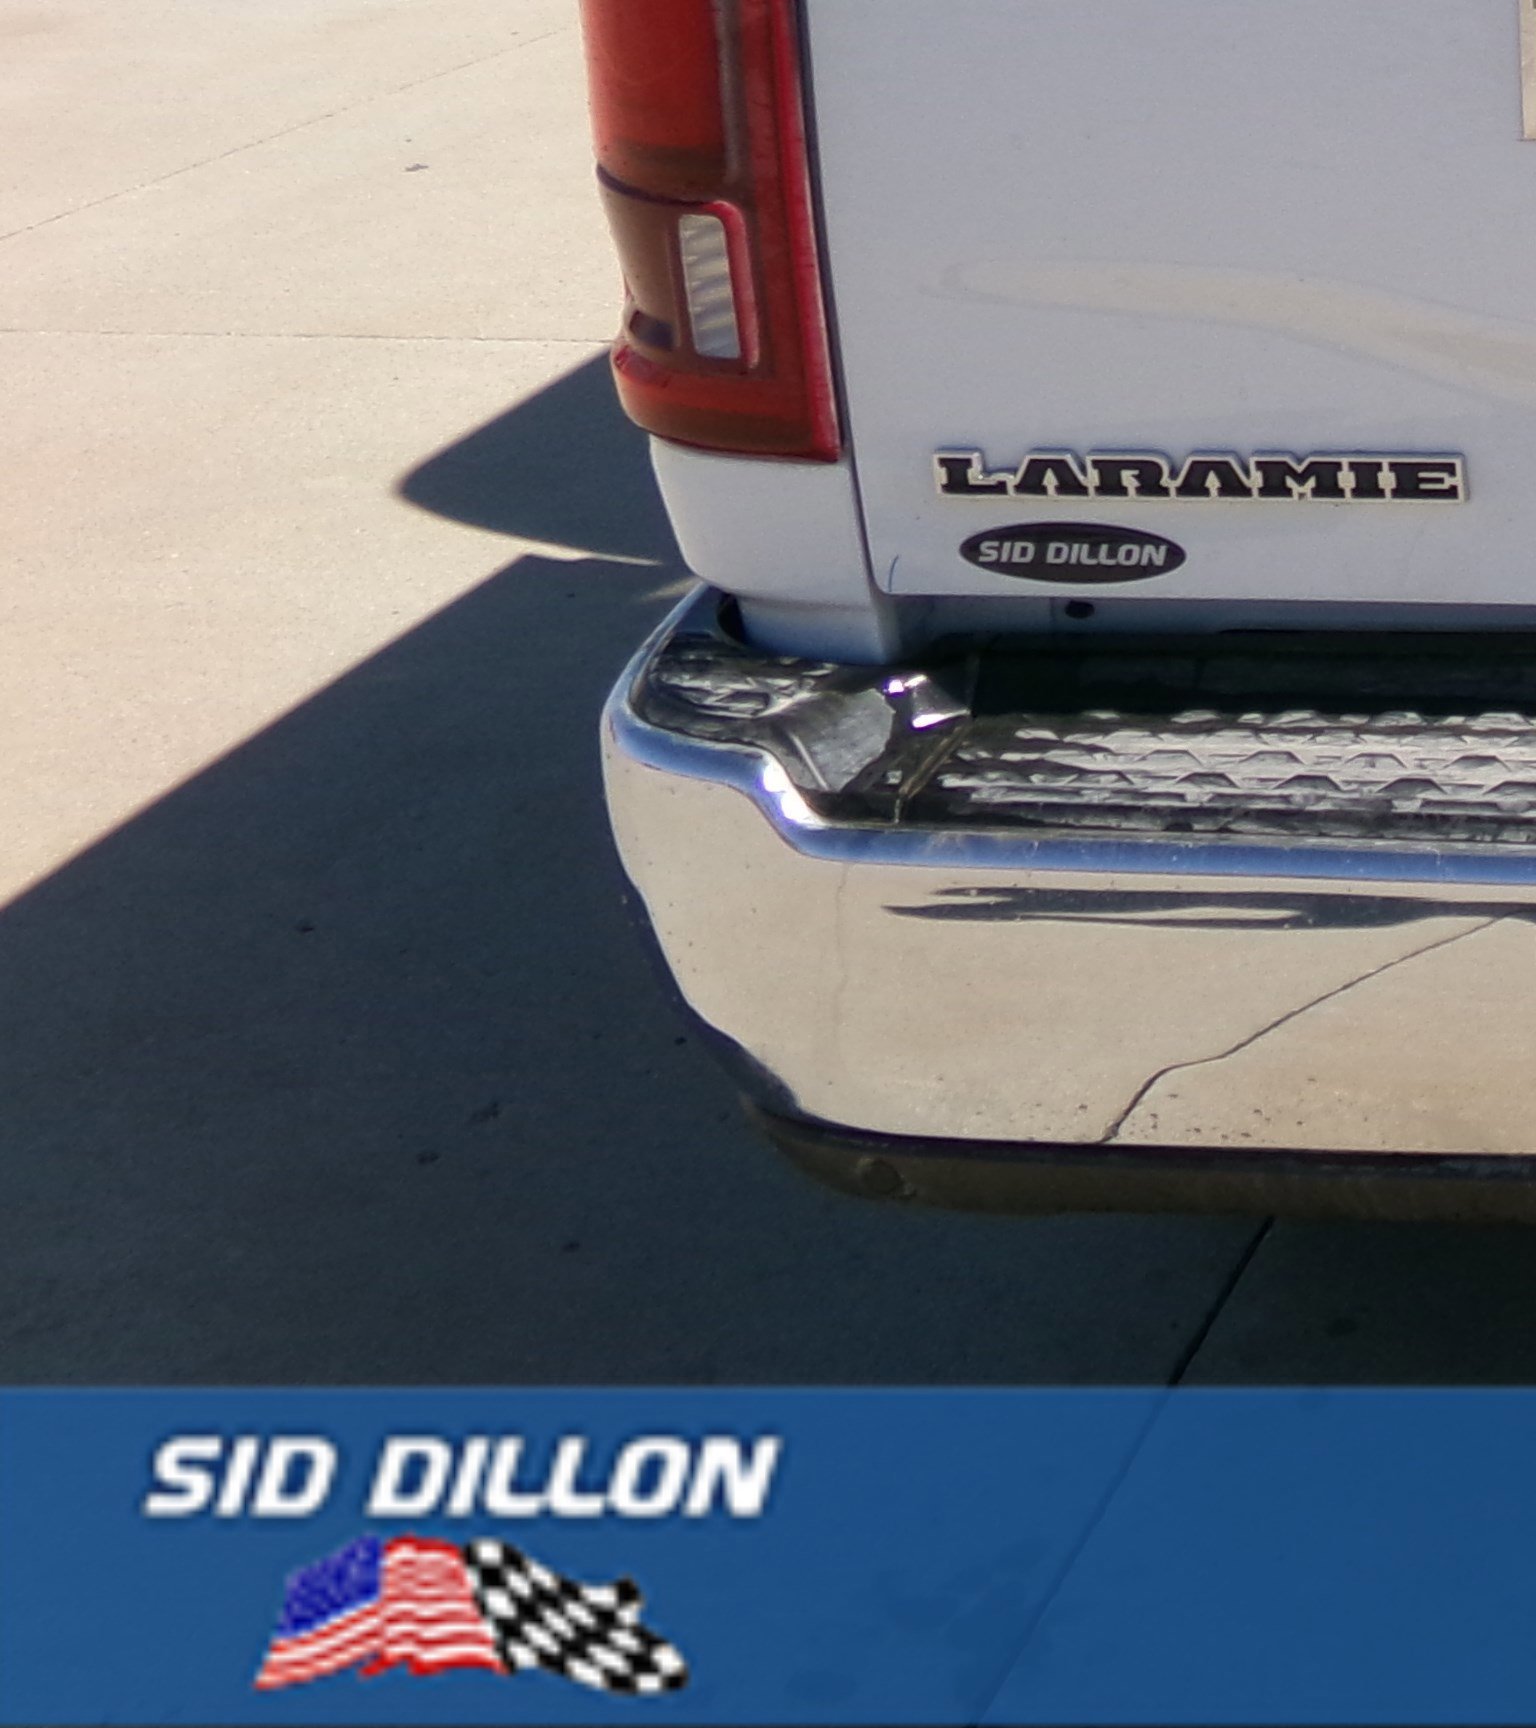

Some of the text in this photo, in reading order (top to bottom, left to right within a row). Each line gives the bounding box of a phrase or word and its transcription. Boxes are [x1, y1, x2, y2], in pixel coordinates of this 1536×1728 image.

[934, 448, 1470, 503] LARAMIE
[978, 541, 1167, 567] SID DILLON
